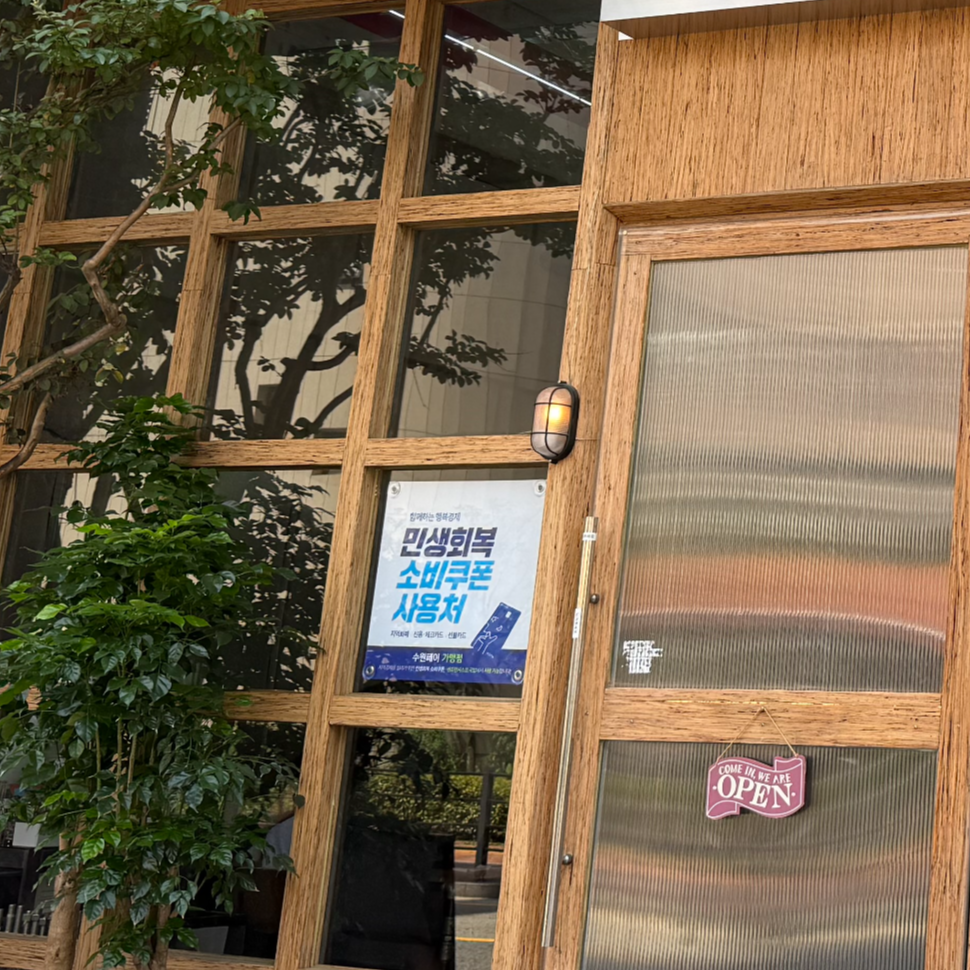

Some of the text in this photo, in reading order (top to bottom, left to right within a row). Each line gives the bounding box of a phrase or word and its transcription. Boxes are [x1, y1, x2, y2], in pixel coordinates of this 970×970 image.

[400, 527, 498, 558] 민생회복
[395, 560, 495, 591] 소비쿠폰
[391, 593, 468, 624] 사용처
[718, 764, 791, 784] COME IN, WE ARE
[717, 774, 793, 809] OPEN
